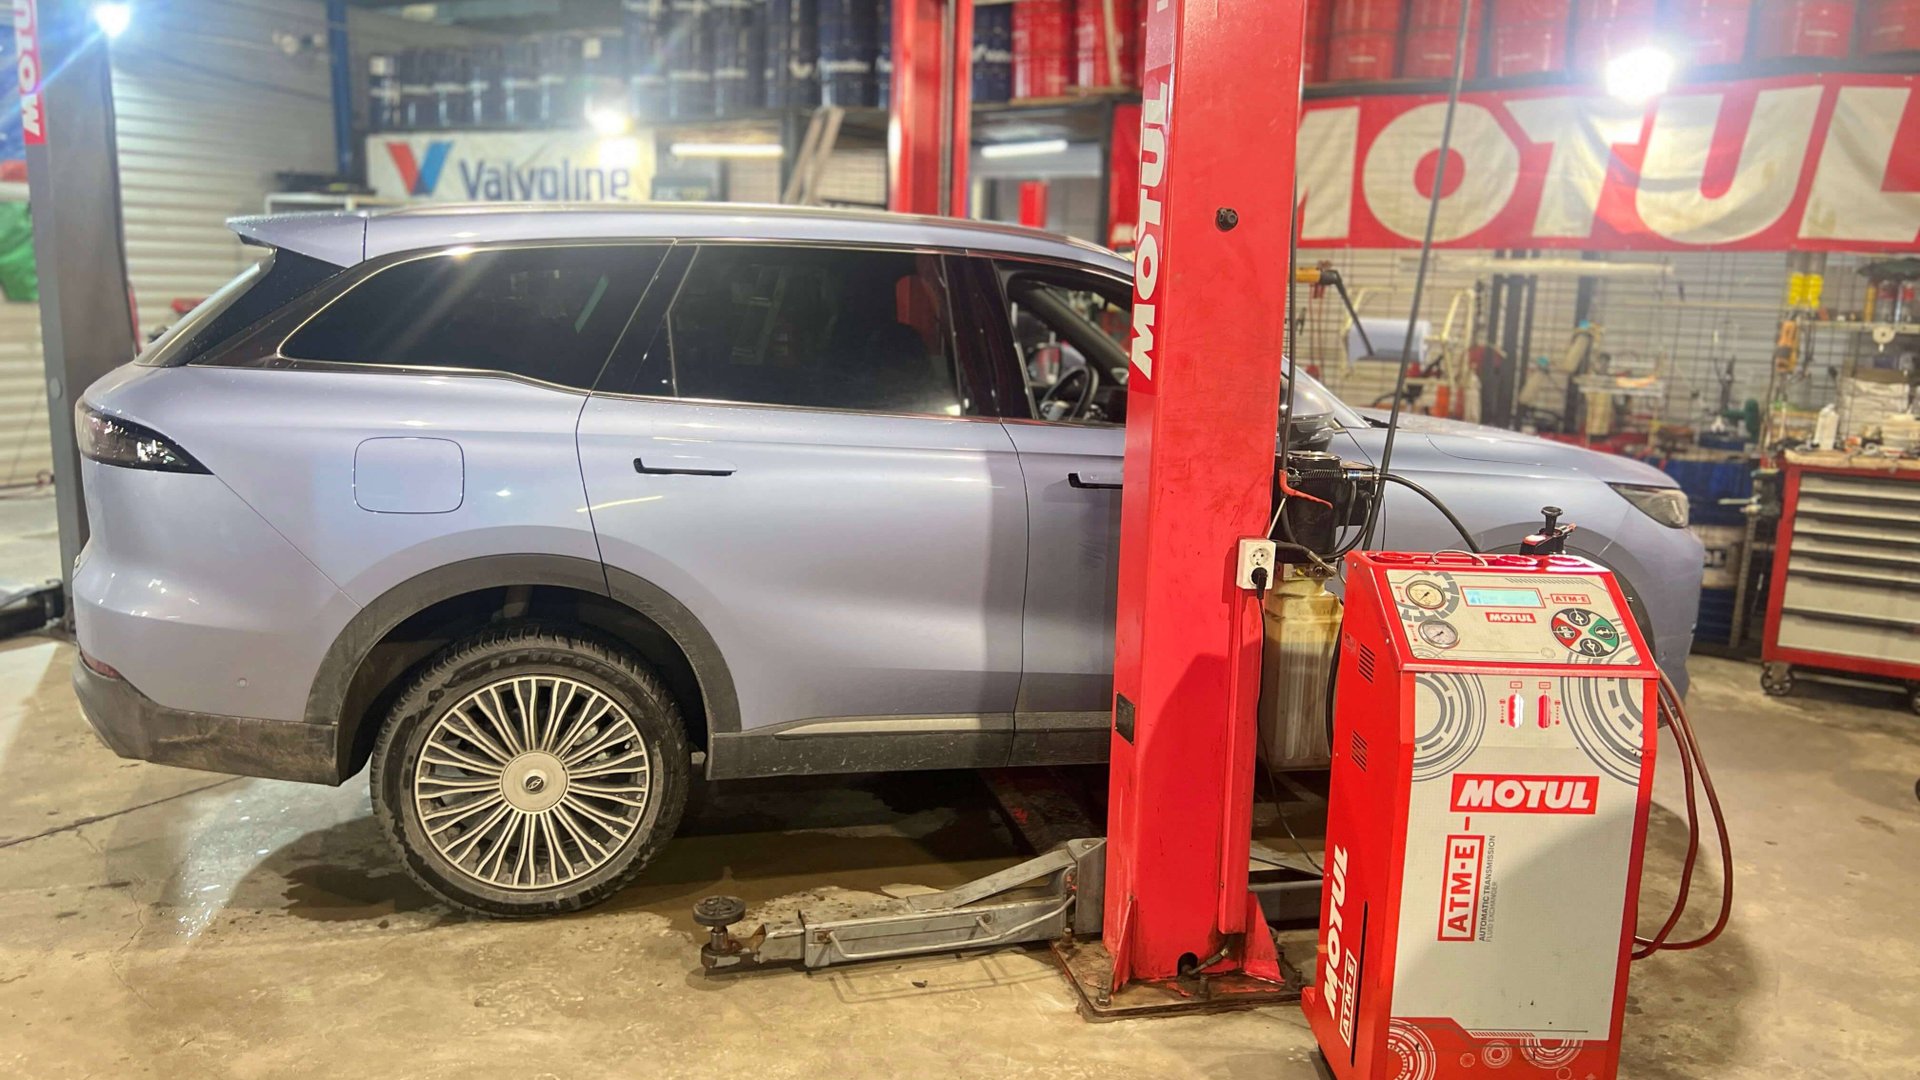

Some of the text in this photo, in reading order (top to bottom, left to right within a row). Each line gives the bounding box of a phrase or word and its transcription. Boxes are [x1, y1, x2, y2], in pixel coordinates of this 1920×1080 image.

[459, 157, 631, 200] Valvoline
[1131, 82, 1169, 381] MOTUL
[1489, 612, 1534, 622] MOTUL
[1555, 594, 1588, 603] ATM-E
[1456, 779, 1591, 809] MOTUL
[1447, 845, 1475, 933] ATM-E
[1479, 835, 1496, 941] AUTOMATIC TRANSMISSION
[1324, 844, 1348, 1020] MOTUL
[1341, 957, 1356, 1038] ATM-E
